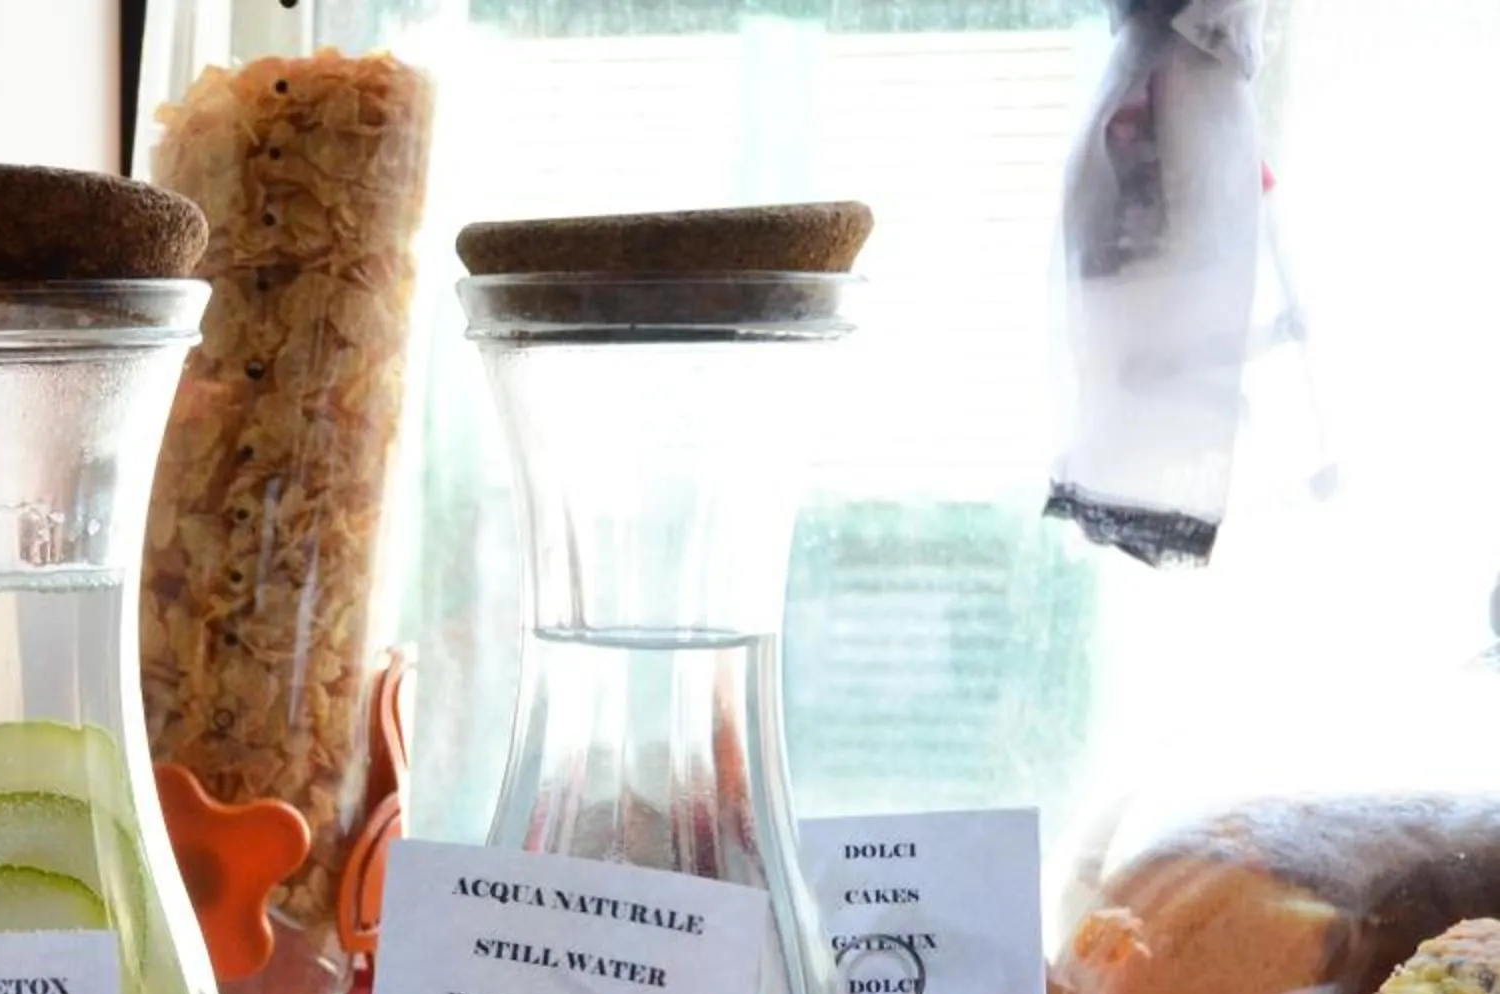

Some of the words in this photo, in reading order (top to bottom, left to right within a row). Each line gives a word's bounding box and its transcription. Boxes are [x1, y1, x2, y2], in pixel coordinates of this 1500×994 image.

[844, 842, 917, 860] DOLCI
[844, 888, 920, 905] CAKES
[452, 876, 546, 907] ACQUA
[552, 890, 705, 936] NATURALE
[831, 933, 936, 951] GTEUX
[473, 937, 559, 969] STILL
[567, 949, 667, 988] WATER
